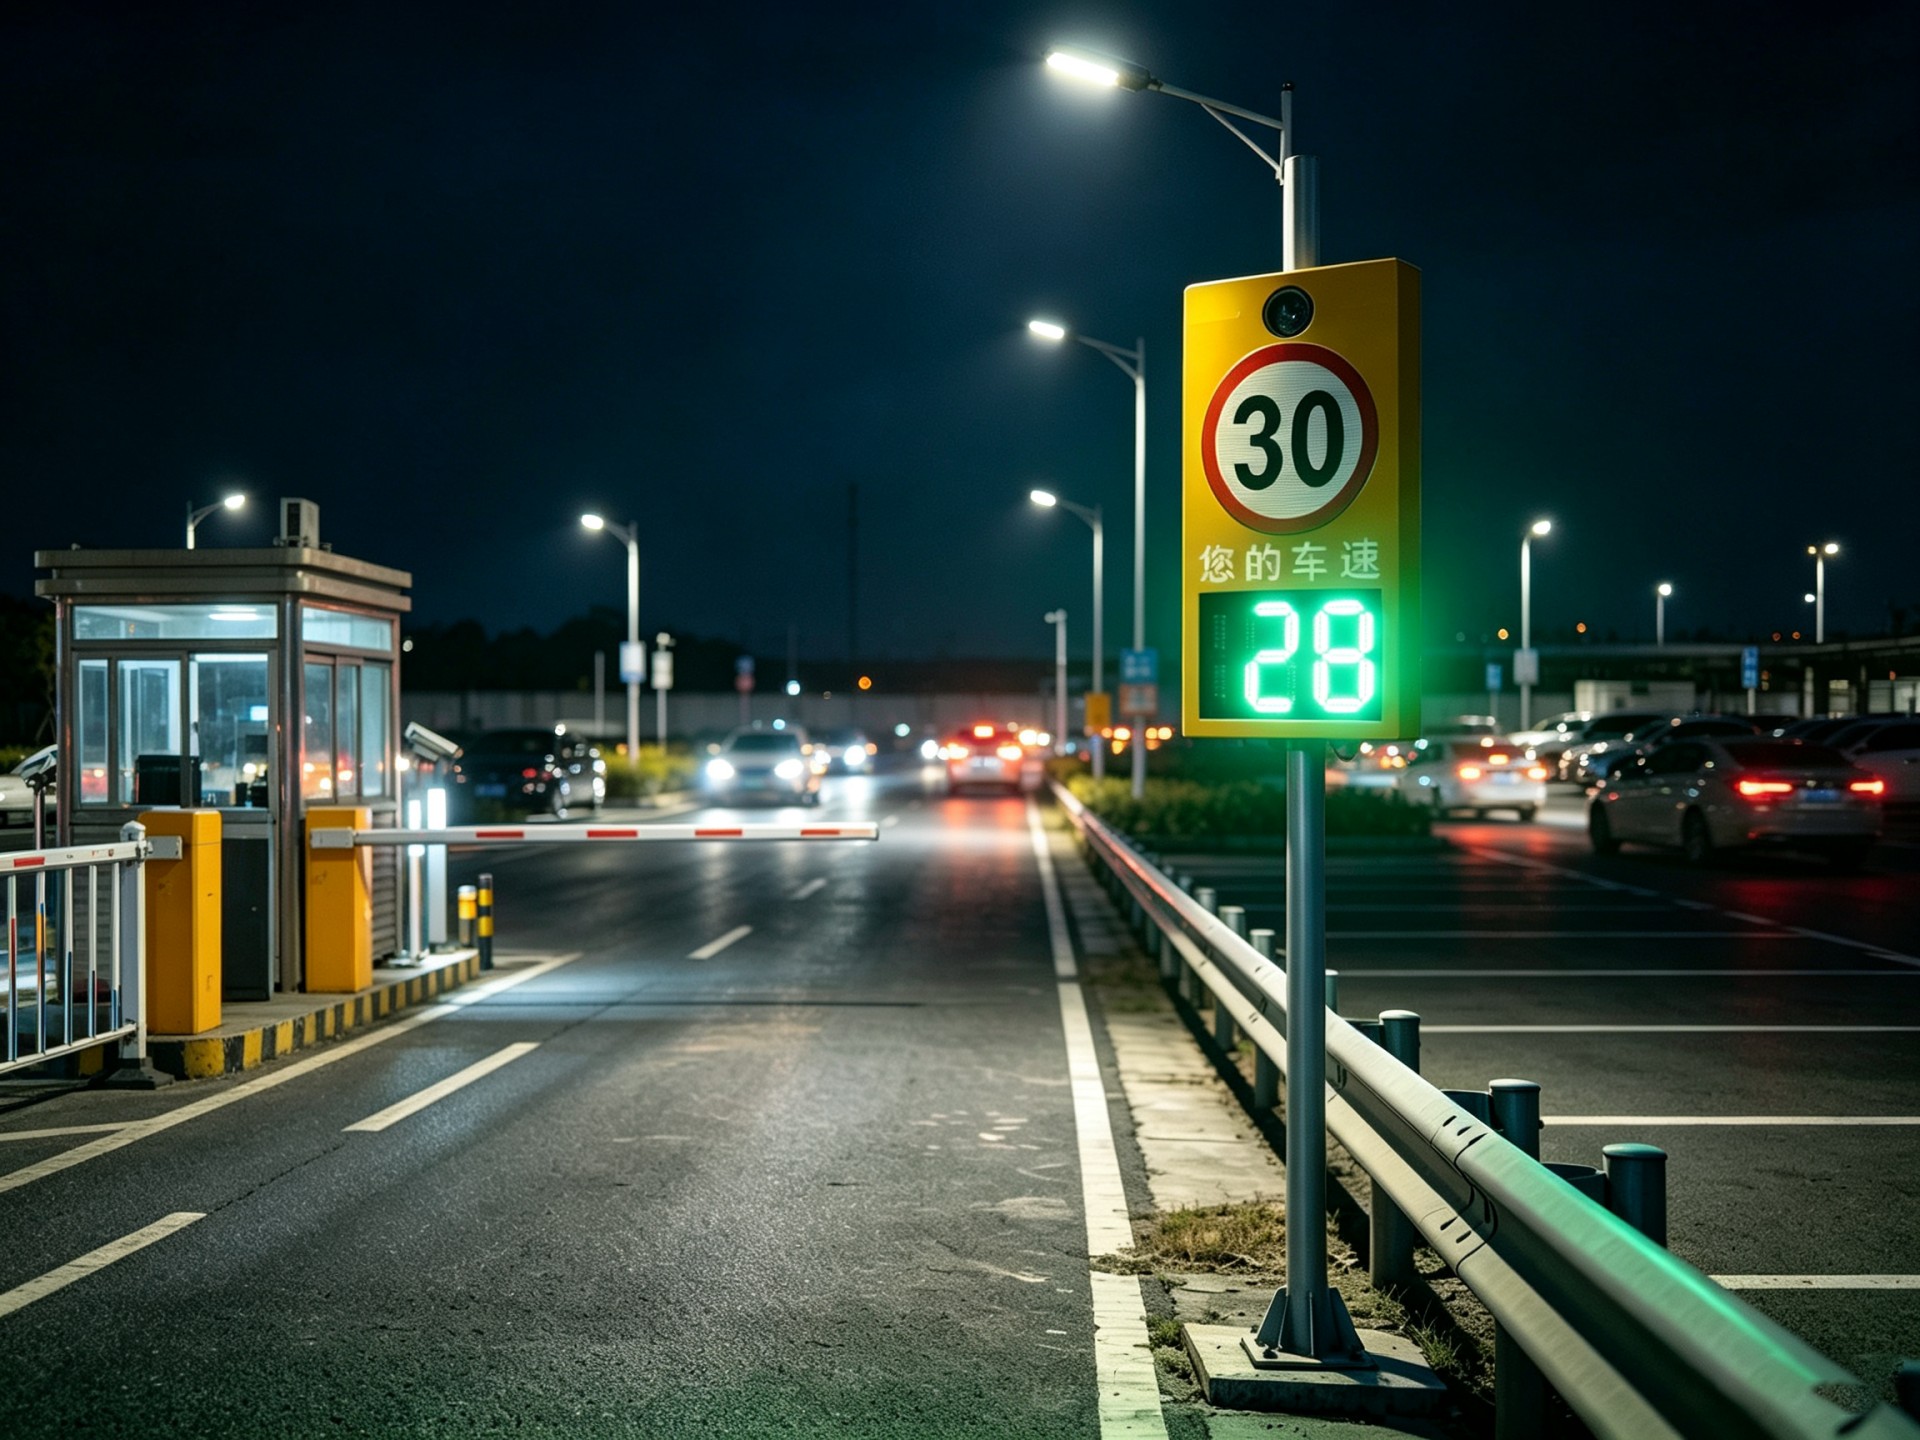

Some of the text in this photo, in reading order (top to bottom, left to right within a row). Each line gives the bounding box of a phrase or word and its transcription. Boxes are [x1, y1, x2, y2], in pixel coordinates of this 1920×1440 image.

[1233, 389, 1345, 491] 30
[1199, 537, 1381, 583] 您的车速
[1244, 599, 1375, 714] 28
